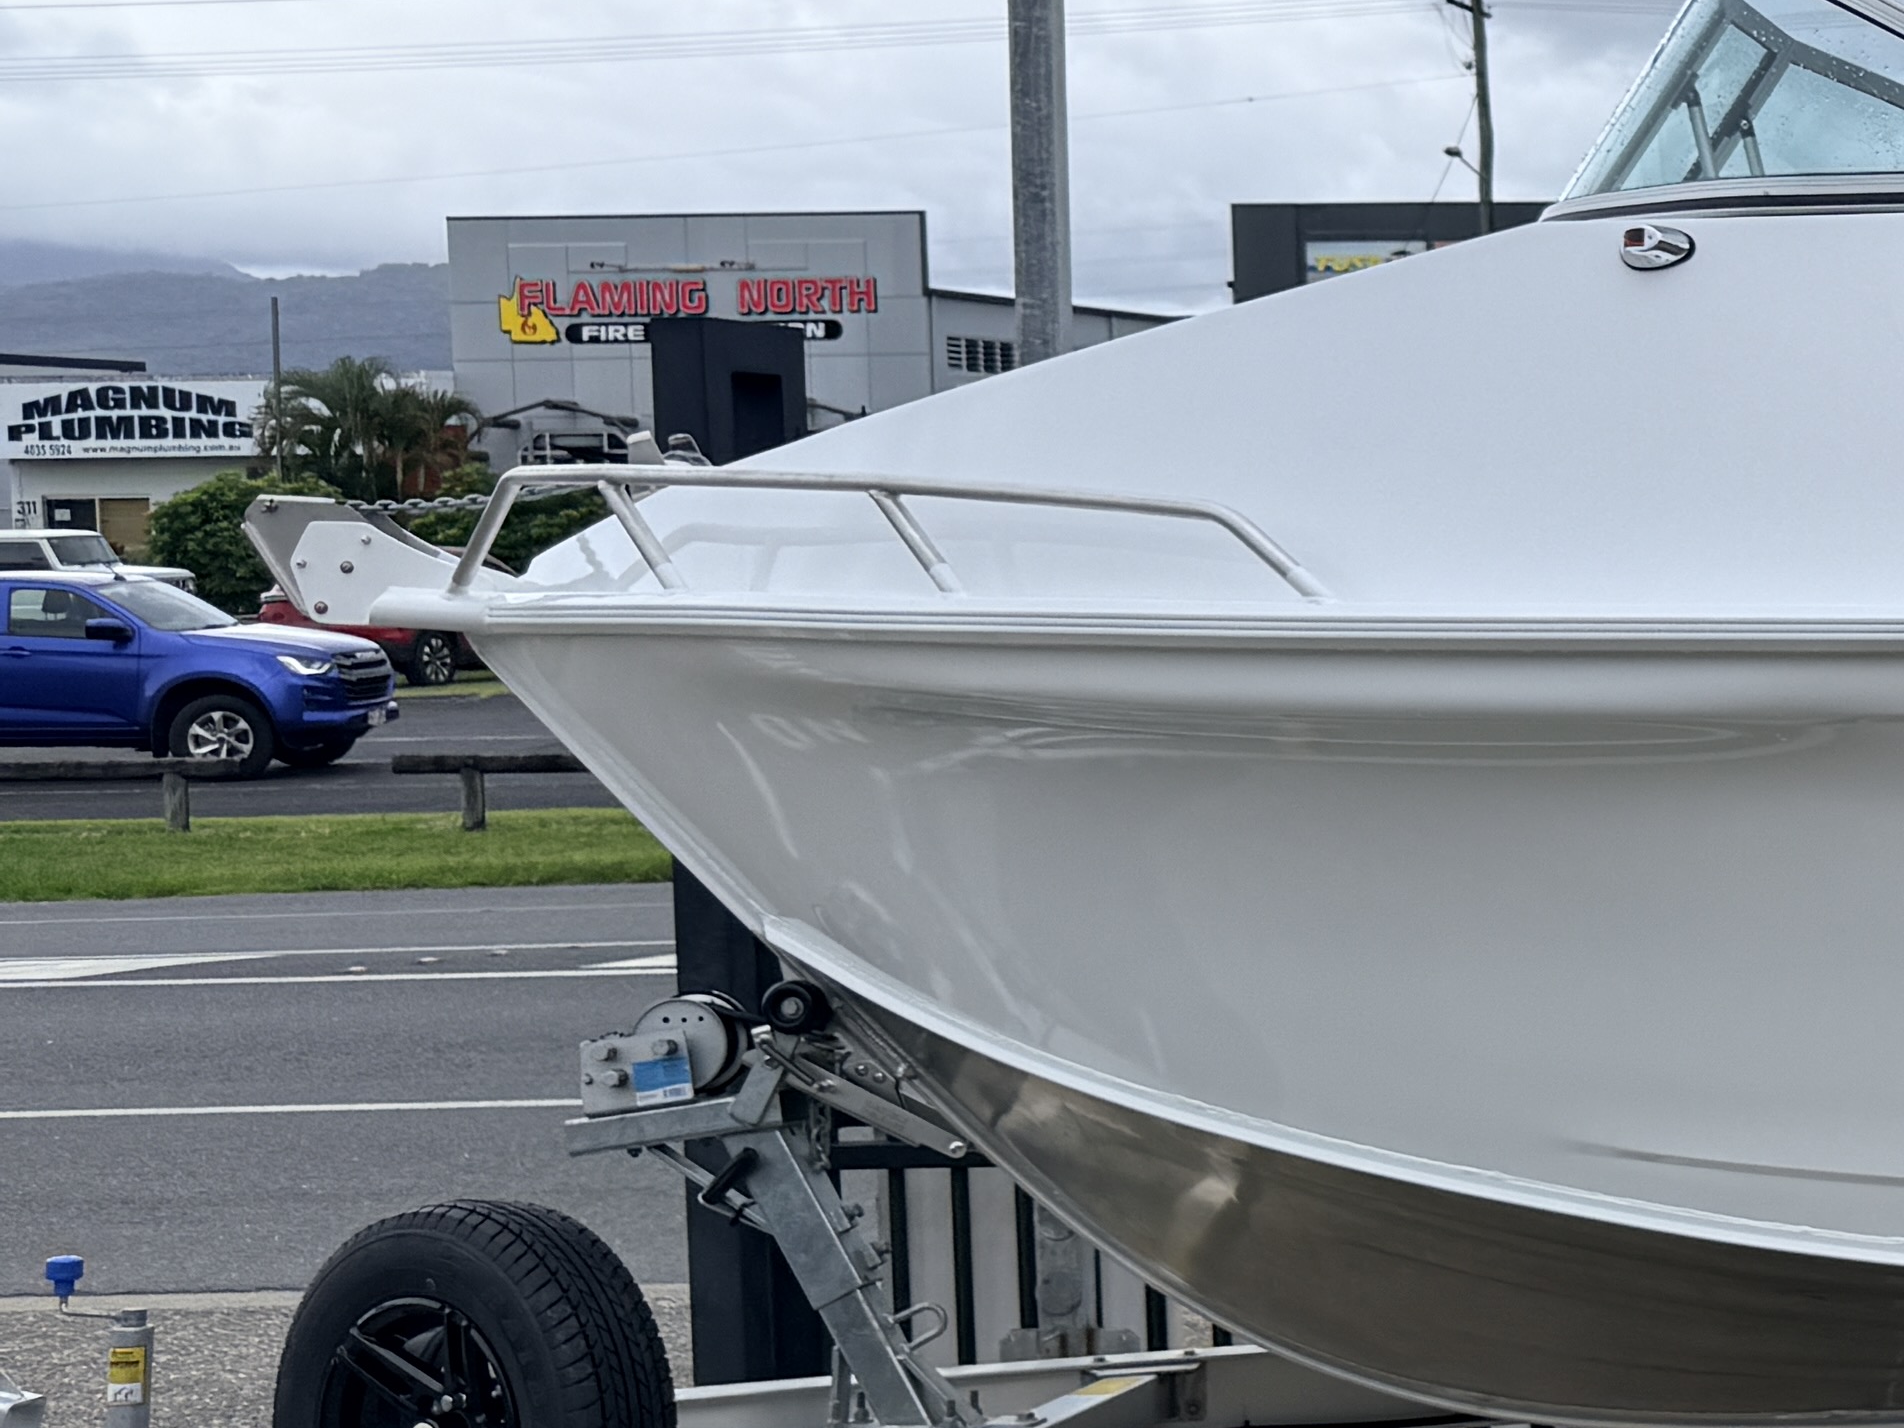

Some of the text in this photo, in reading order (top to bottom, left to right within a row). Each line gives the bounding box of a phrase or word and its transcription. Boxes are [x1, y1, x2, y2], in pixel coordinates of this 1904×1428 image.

[518, 276, 879, 316] FLAMING NORTH
[581, 324, 645, 342] FIRE
[21, 385, 238, 421] MAGNUM
[7, 415, 254, 442] PLUMBING
